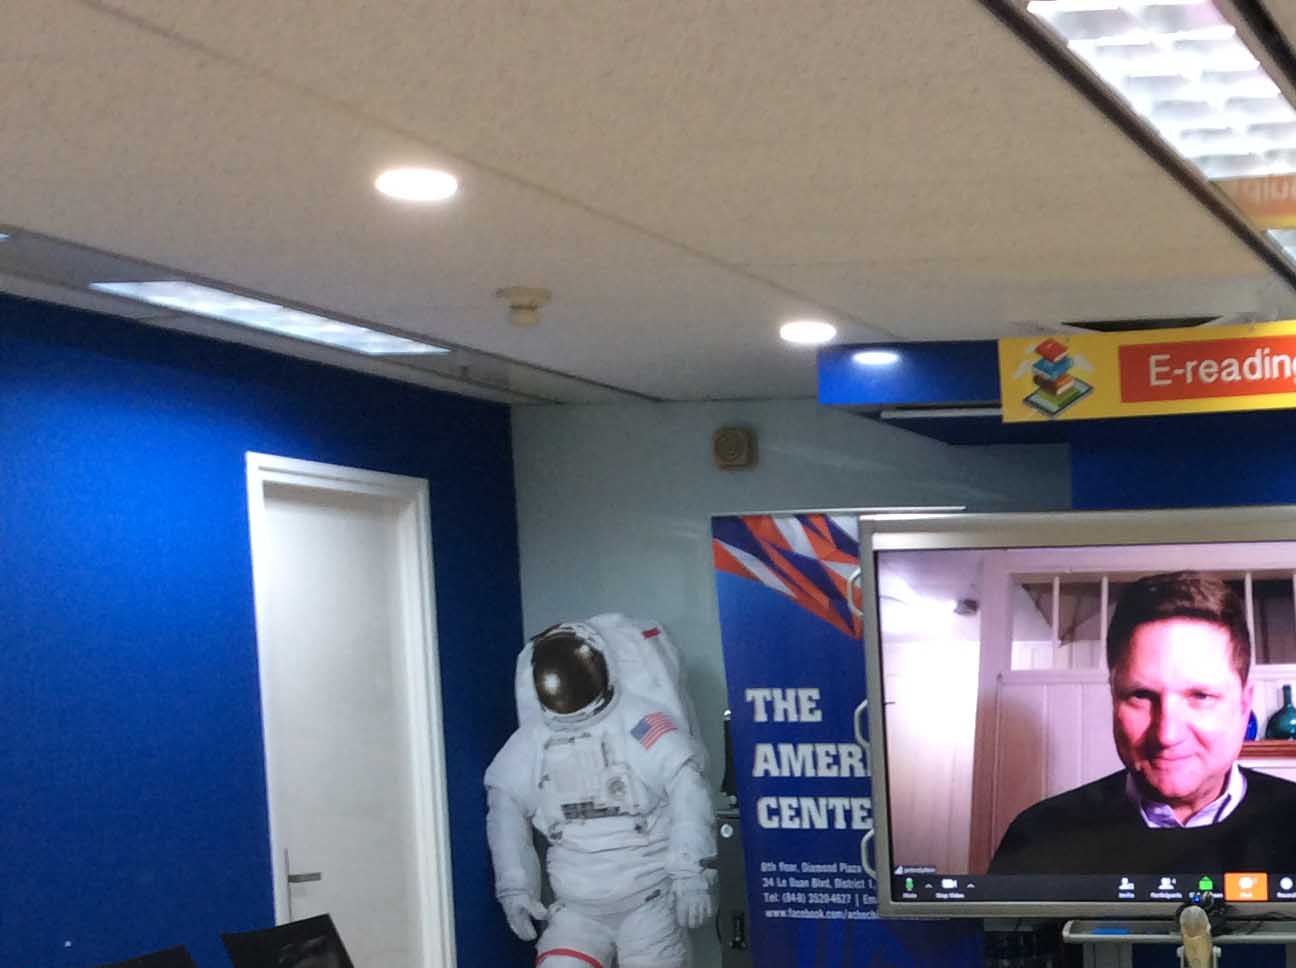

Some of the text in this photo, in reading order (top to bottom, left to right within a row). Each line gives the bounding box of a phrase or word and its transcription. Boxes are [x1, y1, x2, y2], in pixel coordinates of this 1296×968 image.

[745, 687, 823, 722] THE
[752, 743, 872, 777] AMER
[757, 796, 874, 829] CENTE
